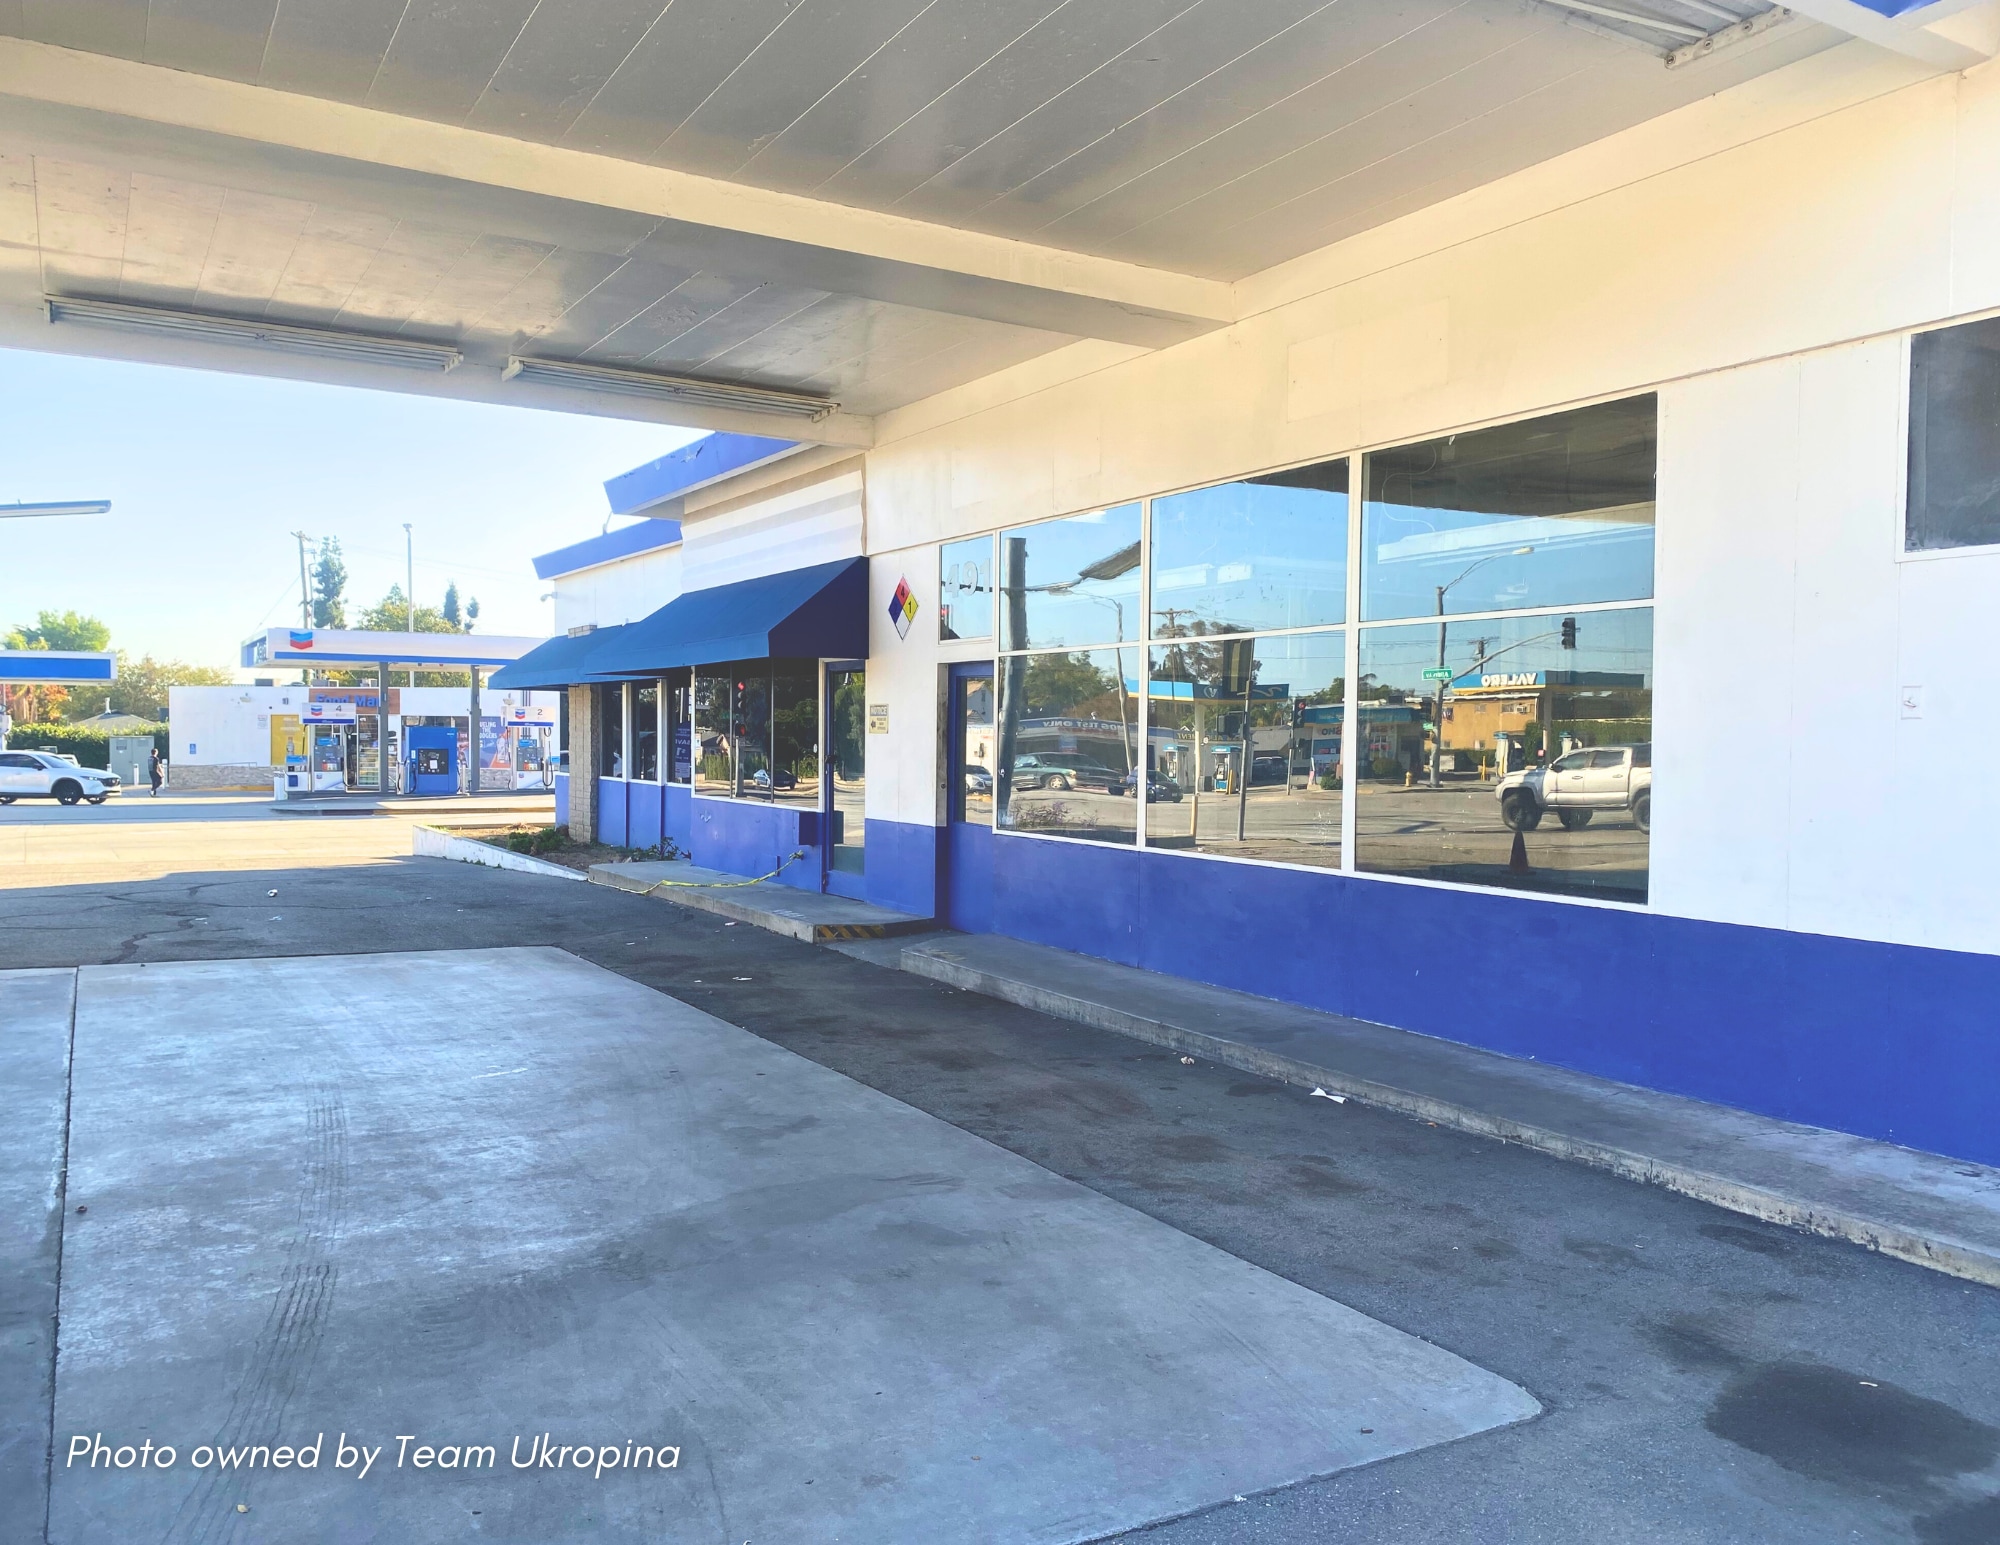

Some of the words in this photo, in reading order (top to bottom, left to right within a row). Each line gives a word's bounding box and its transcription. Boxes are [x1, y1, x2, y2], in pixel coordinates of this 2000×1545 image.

[945, 558, 990, 598] 491
[900, 586, 905, 598] 4
[908, 601, 912, 614] 1
[354, 695, 381, 707] Mar
